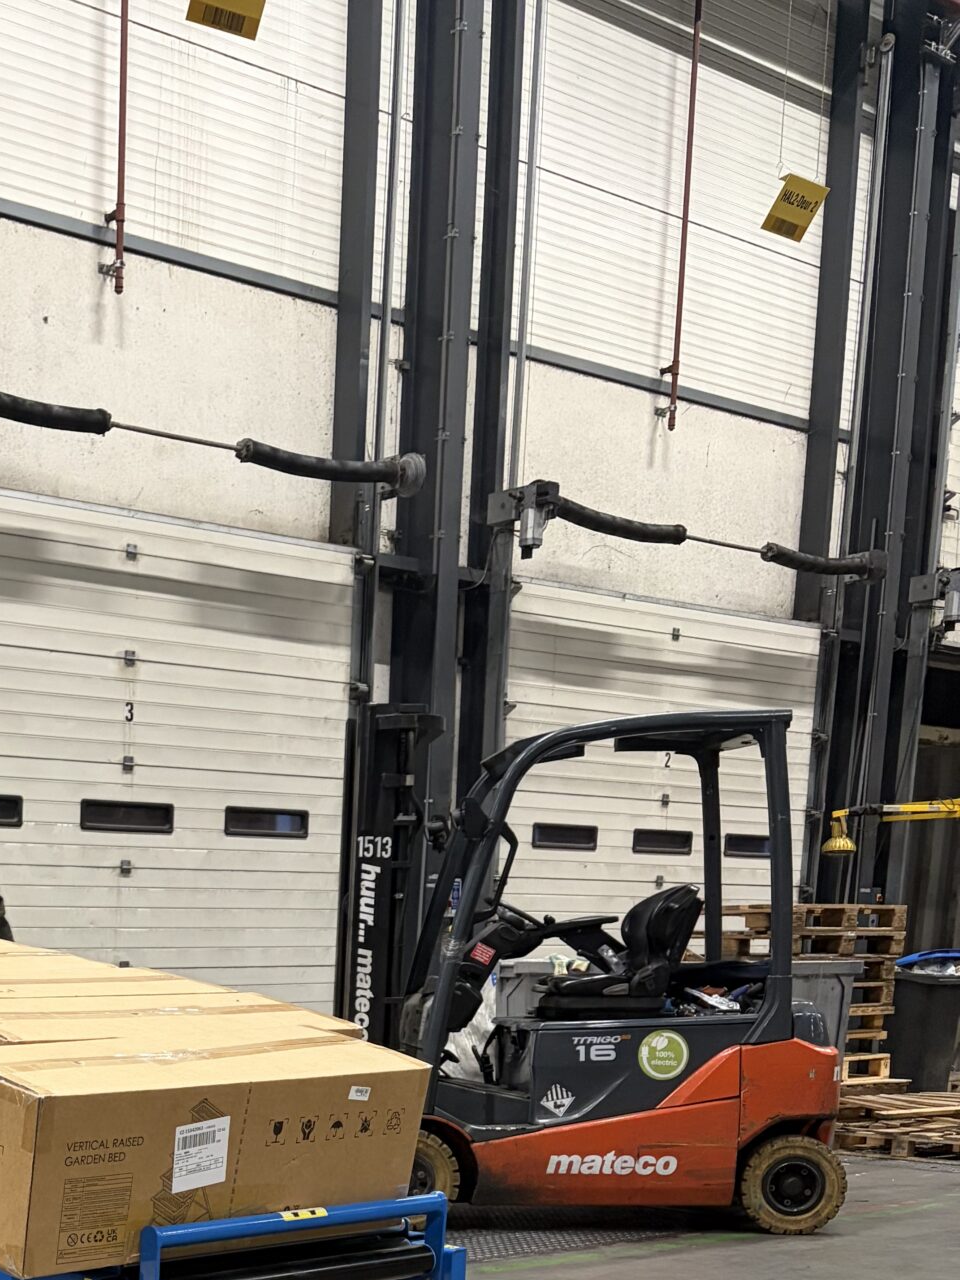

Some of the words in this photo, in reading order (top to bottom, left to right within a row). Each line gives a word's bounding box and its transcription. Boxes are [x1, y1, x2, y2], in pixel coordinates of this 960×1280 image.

[125, 701, 134, 722] 3
[664, 752, 671, 768] 2
[357, 836, 392, 858] 1513
[575, 1044, 616, 1061] 16
[651, 1058, 678, 1066] electric
[66, 1138, 110, 1152] VERTICAL
[112, 1136, 145, 1148] RAISED
[64, 1153, 106, 1167] GARDEN
[107, 1151, 126, 1163] BED
[546, 1150, 678, 1176] mateco
